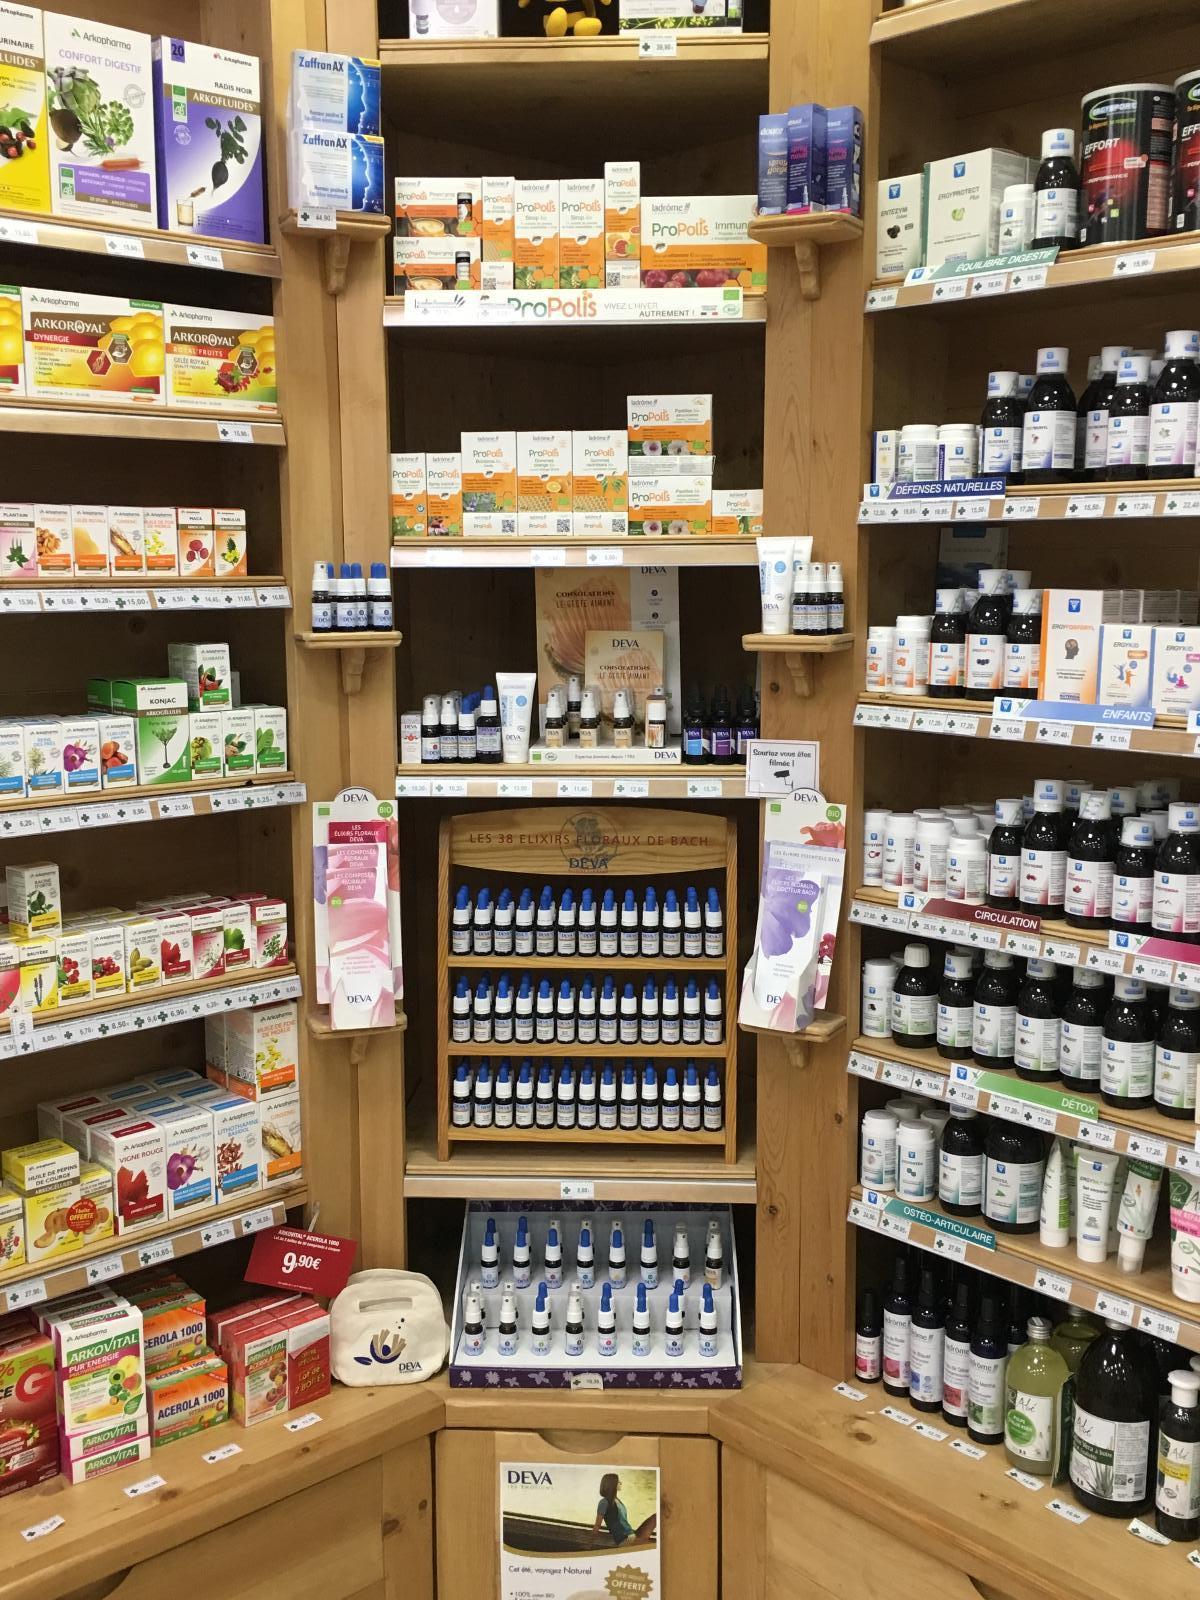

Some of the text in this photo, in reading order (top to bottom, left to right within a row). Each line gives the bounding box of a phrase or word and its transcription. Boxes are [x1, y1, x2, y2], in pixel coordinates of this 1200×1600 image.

[83, 31, 132, 51] Arkopharma
[171, 43, 185, 57] 20
[58, 48, 142, 74] CONFORT DIGESTIF
[213, 81, 253, 95] RADIS NOIR
[192, 92, 255, 112] ARKOFLUIDES
[1084, 137, 1120, 155] EFFORT
[516, 199, 556, 212] ProPolis
[561, 199, 601, 212] ProPolis
[652, 203, 684, 213] ladrôme
[652, 217, 710, 237] ProPolis
[955, 249, 1053, 273] ÉQUILIBRE DIGESTIF
[40, 296, 80, 307] Arkopharma
[604, 302, 626, 310] VIVEZ
[639, 310, 689, 318] AUTREMENT
[33, 332, 70, 344] DYNERGIE
[198, 348, 223, 358] FRUITS
[632, 409, 670, 422] ProPolis
[473, 447, 504, 459] ProPolis
[529, 447, 560, 458] ProPolis
[584, 447, 615, 457] ProPolis
[392, 468, 424, 479] ProPolis
[895, 480, 1003, 495] DÉFENSES NATURELLES
[632, 489, 670, 502] ProPolis
[764, 602, 779, 611] DEVA
[612, 639, 639, 648] DEVA
[149, 696, 177, 705] KONJAC
[1101, 709, 1152, 722] ENFANTS
[654, 751, 678, 760] DEVA
[752, 747, 777, 758] Souriez
[778, 750, 794, 758] vous
[343, 793, 369, 803] DEVA
[793, 793, 819, 804] DEVA
[379, 806, 392, 814] BIO
[827, 809, 840, 818] BIO
[469, 833, 709, 848] LES 38 ELIXIRS FLORAUX DE BACH
[568, 857, 608, 870] DEVA
[974, 908, 1038, 930] CIRCULATION
[347, 994, 372, 1004] DEVA
[1060, 1095, 1096, 1115] DÉTOX
[119, 1146, 164, 1164] VIGNE ROUGE
[903, 1205, 993, 1245] OSTÉO-ARTICULAIRE
[281, 1252, 322, 1274] 9,90€
[181, 1322, 203, 1337] 1000
[69, 1335, 138, 1364] ARKOVITAL
[155, 1359, 207, 1380] ACEROLA 1000
[398, 1361, 422, 1372] DEVA
[158, 1387, 225, 1421] ACEROLA 1000
[84, 1424, 137, 1447] ARKOVITAL
[87, 1447, 138, 1471] ARKOVITAL
[508, 1470, 553, 1485] DEVA
[508, 1565, 520, 1573] Cet
[535, 1567, 562, 1576] voyagez
[563, 1566, 592, 1575] Naturel
[611, 1581, 647, 1592] OFFERTE
